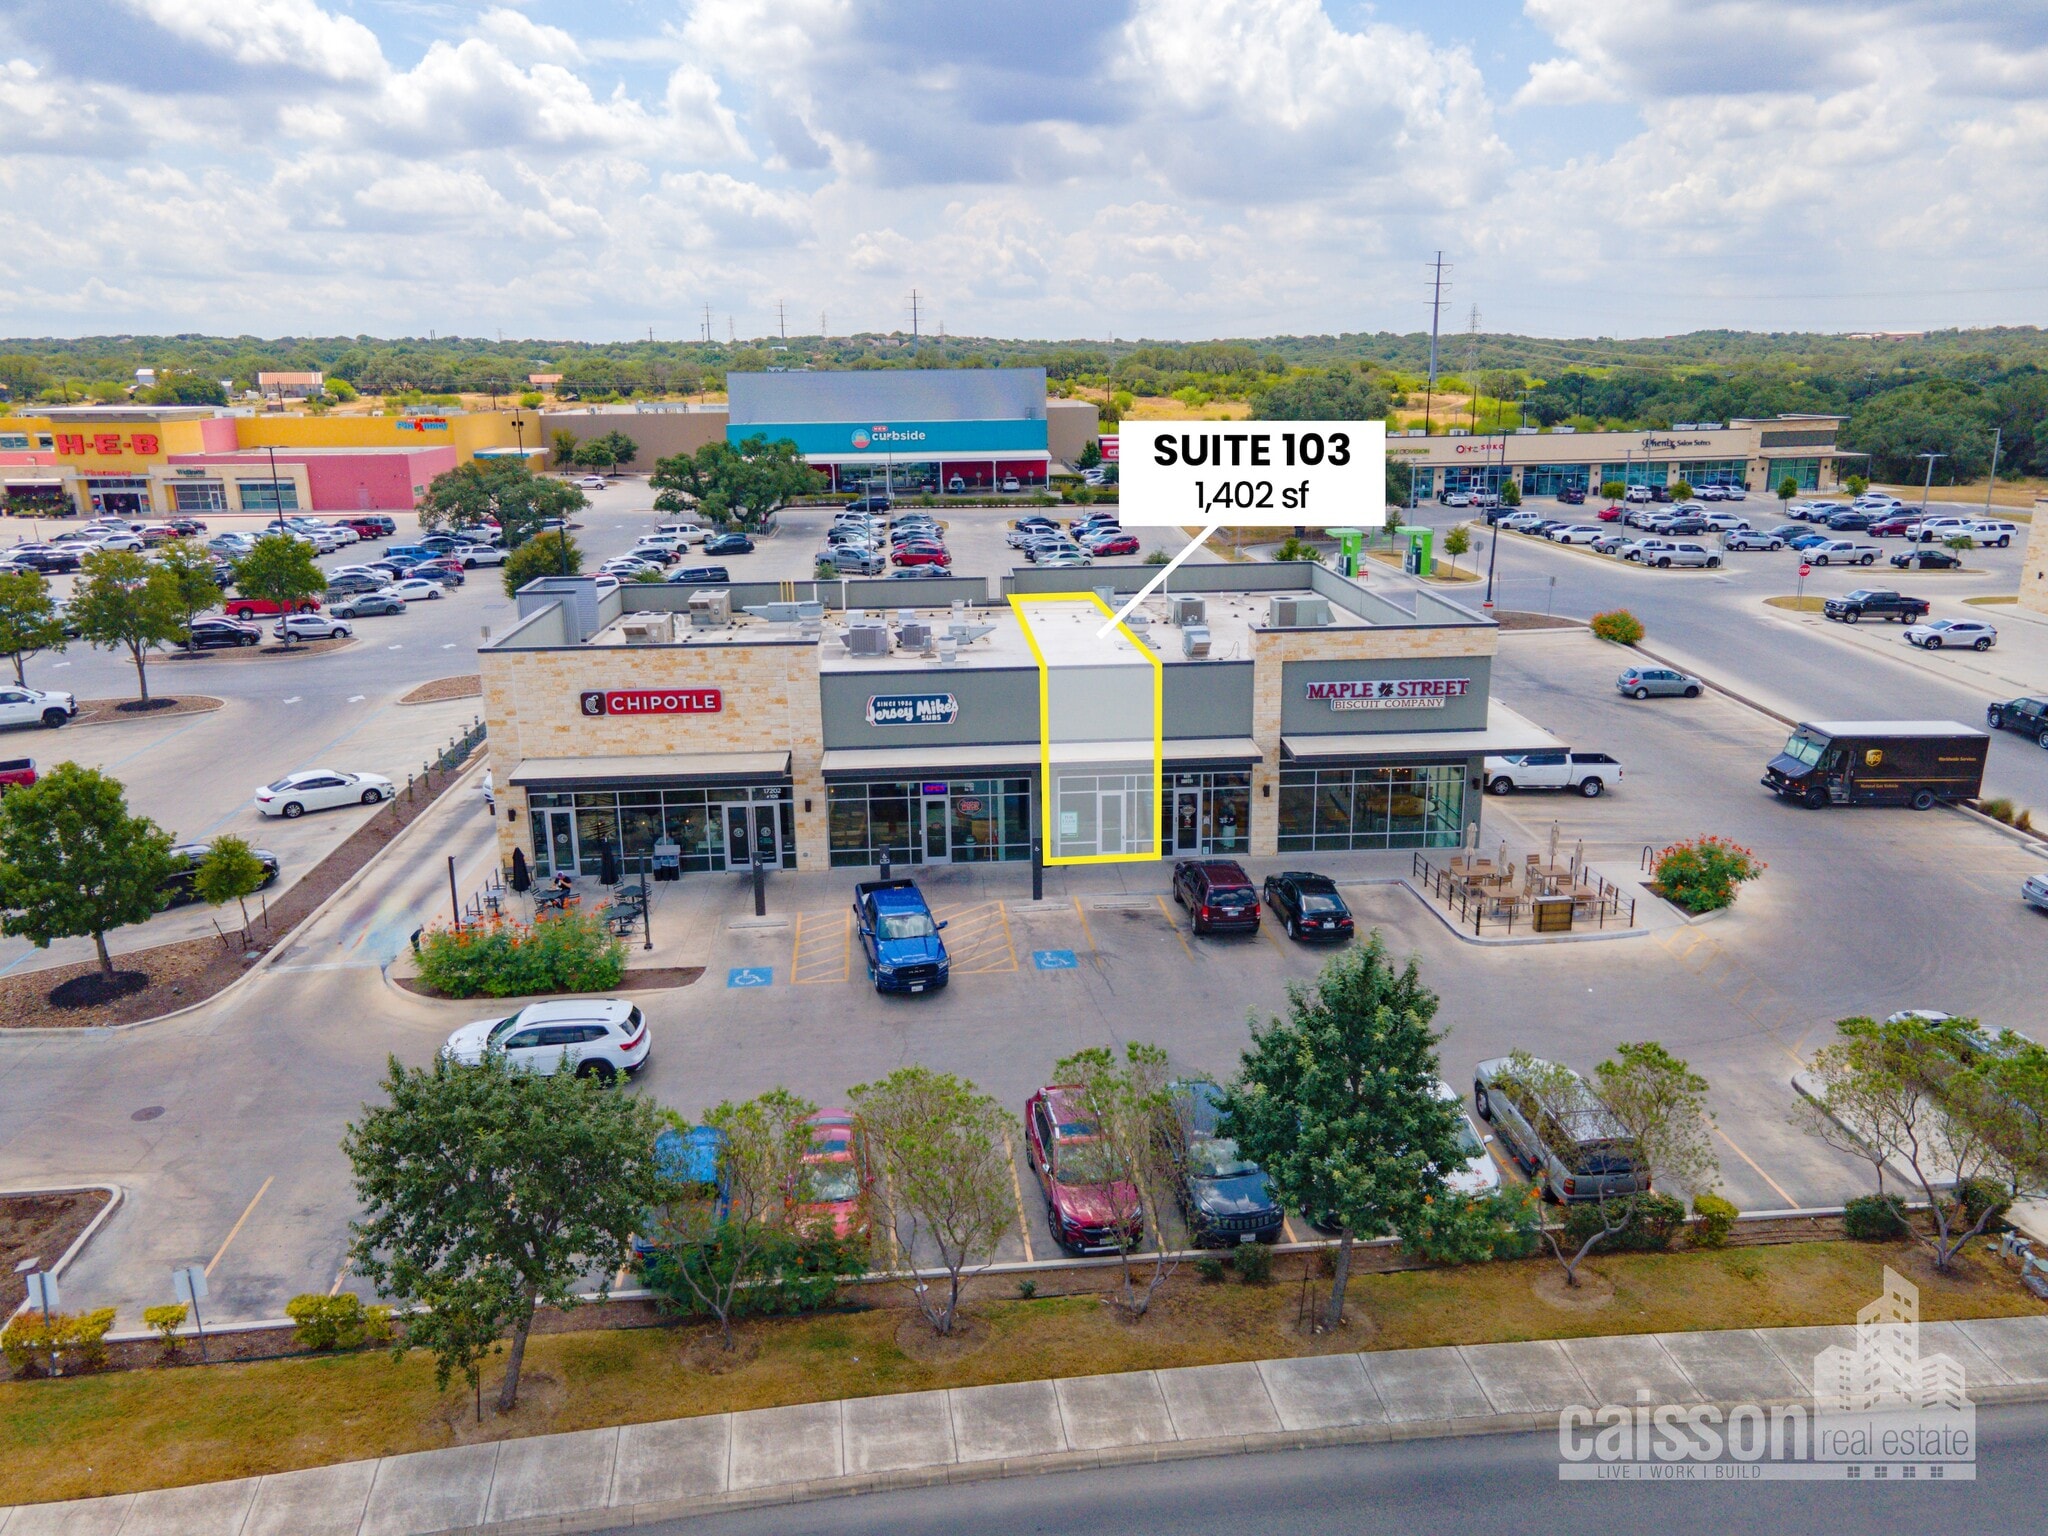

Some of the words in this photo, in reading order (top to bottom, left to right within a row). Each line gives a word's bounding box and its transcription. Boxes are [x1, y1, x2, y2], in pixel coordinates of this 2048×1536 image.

[872, 431, 926, 441] curbside
[56, 434, 159, 455] H-E-B
[1308, 683, 1373, 698] MAPLE
[1397, 680, 1469, 696] STREET
[611, 695, 716, 711] CHIPOTLE
[1334, 700, 1380, 710] BISCUIT
[1384, 699, 1444, 709] COMPANY
[866, 706, 914, 721] Jersey
[1867, 754, 1881, 764] ups
